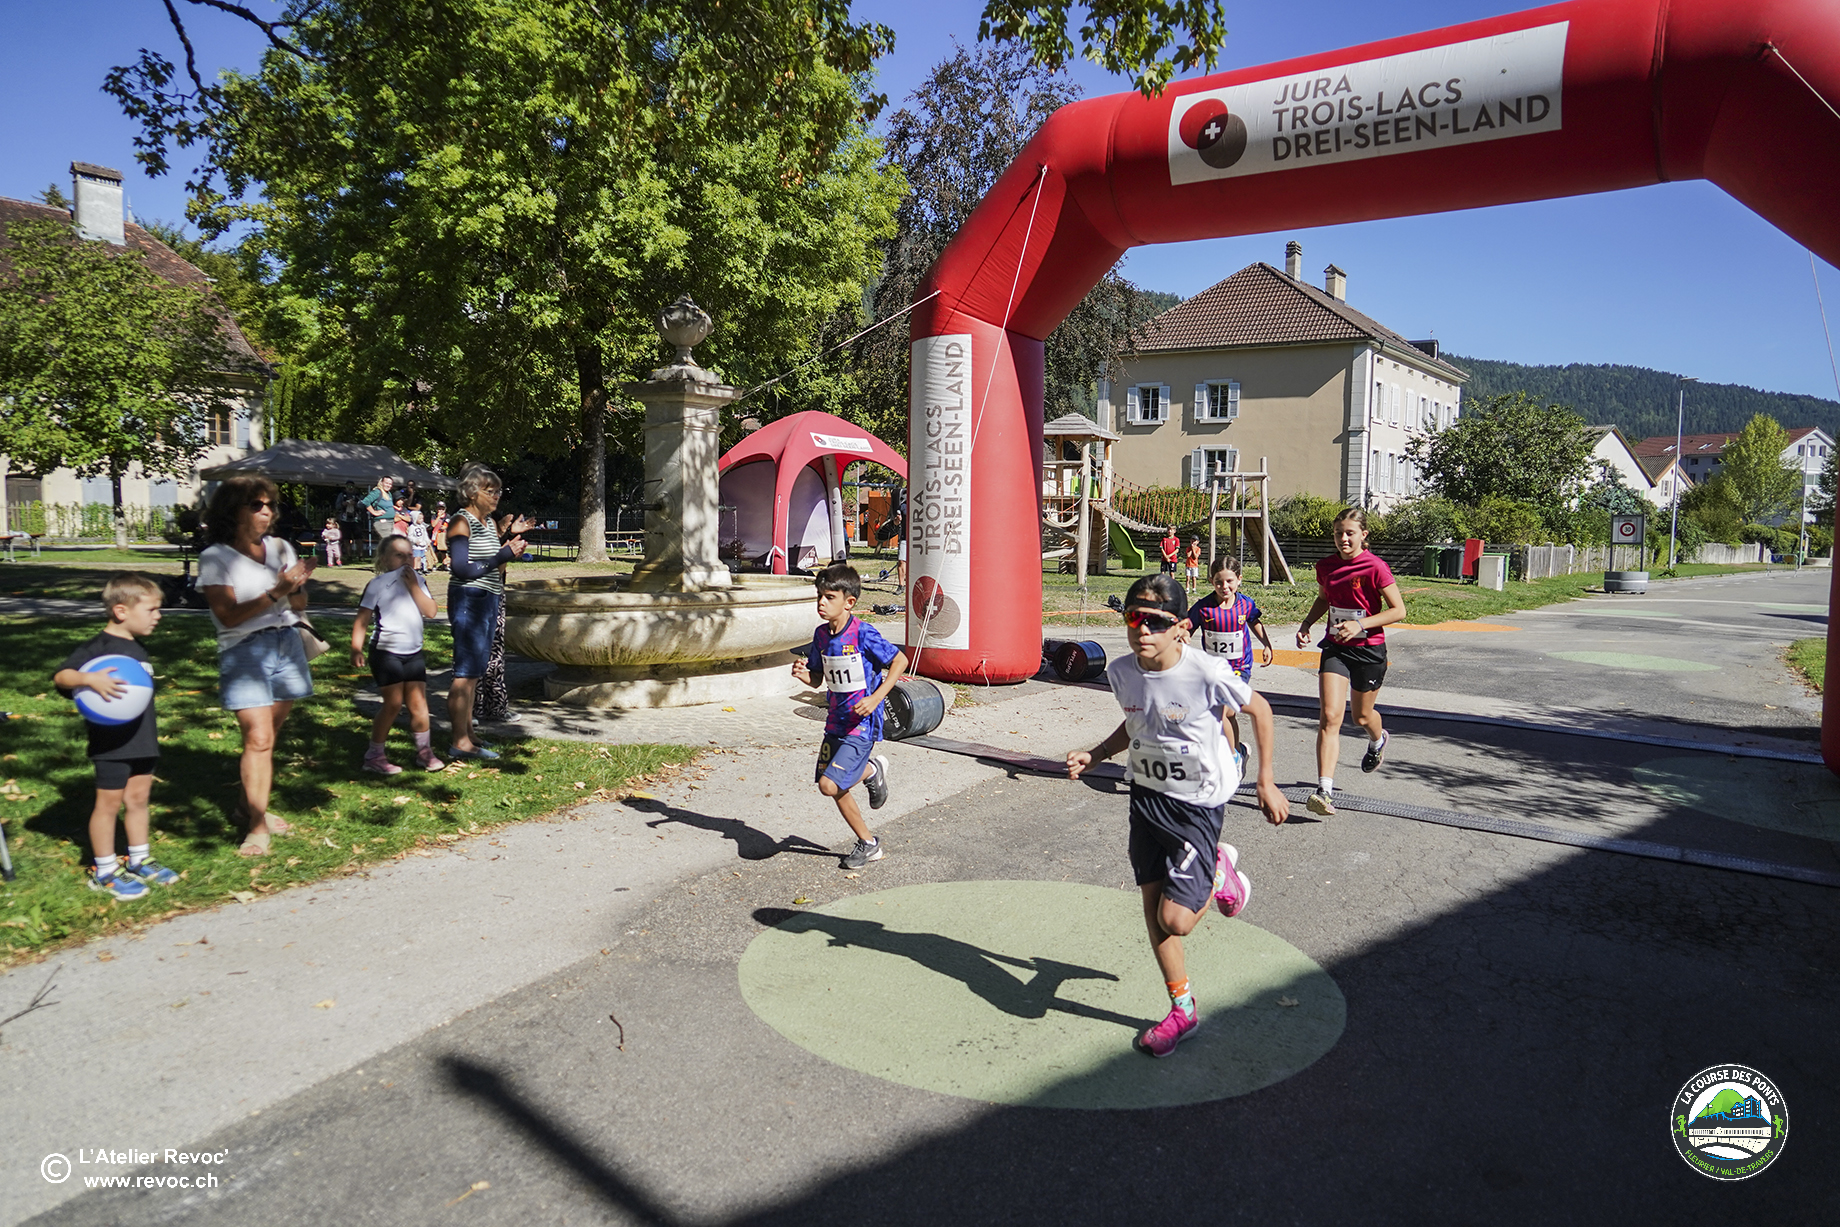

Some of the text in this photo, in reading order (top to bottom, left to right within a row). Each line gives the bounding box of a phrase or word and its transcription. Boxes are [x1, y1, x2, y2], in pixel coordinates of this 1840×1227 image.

[1272, 78, 1463, 133] TROIS-LACS
[1273, 74, 1351, 106] JURA
[1273, 94, 1550, 162] DREI-SEEN-LAND
[944, 342, 963, 554] DREI-SEEN-LAND
[925, 404, 942, 555] TROIS-LACS
[913, 490, 924, 555] JURA
[1212, 641, 1234, 653] 121
[829, 669, 851, 684] 111
[821, 742, 831, 761] 9
[1140, 758, 1186, 781] 105
